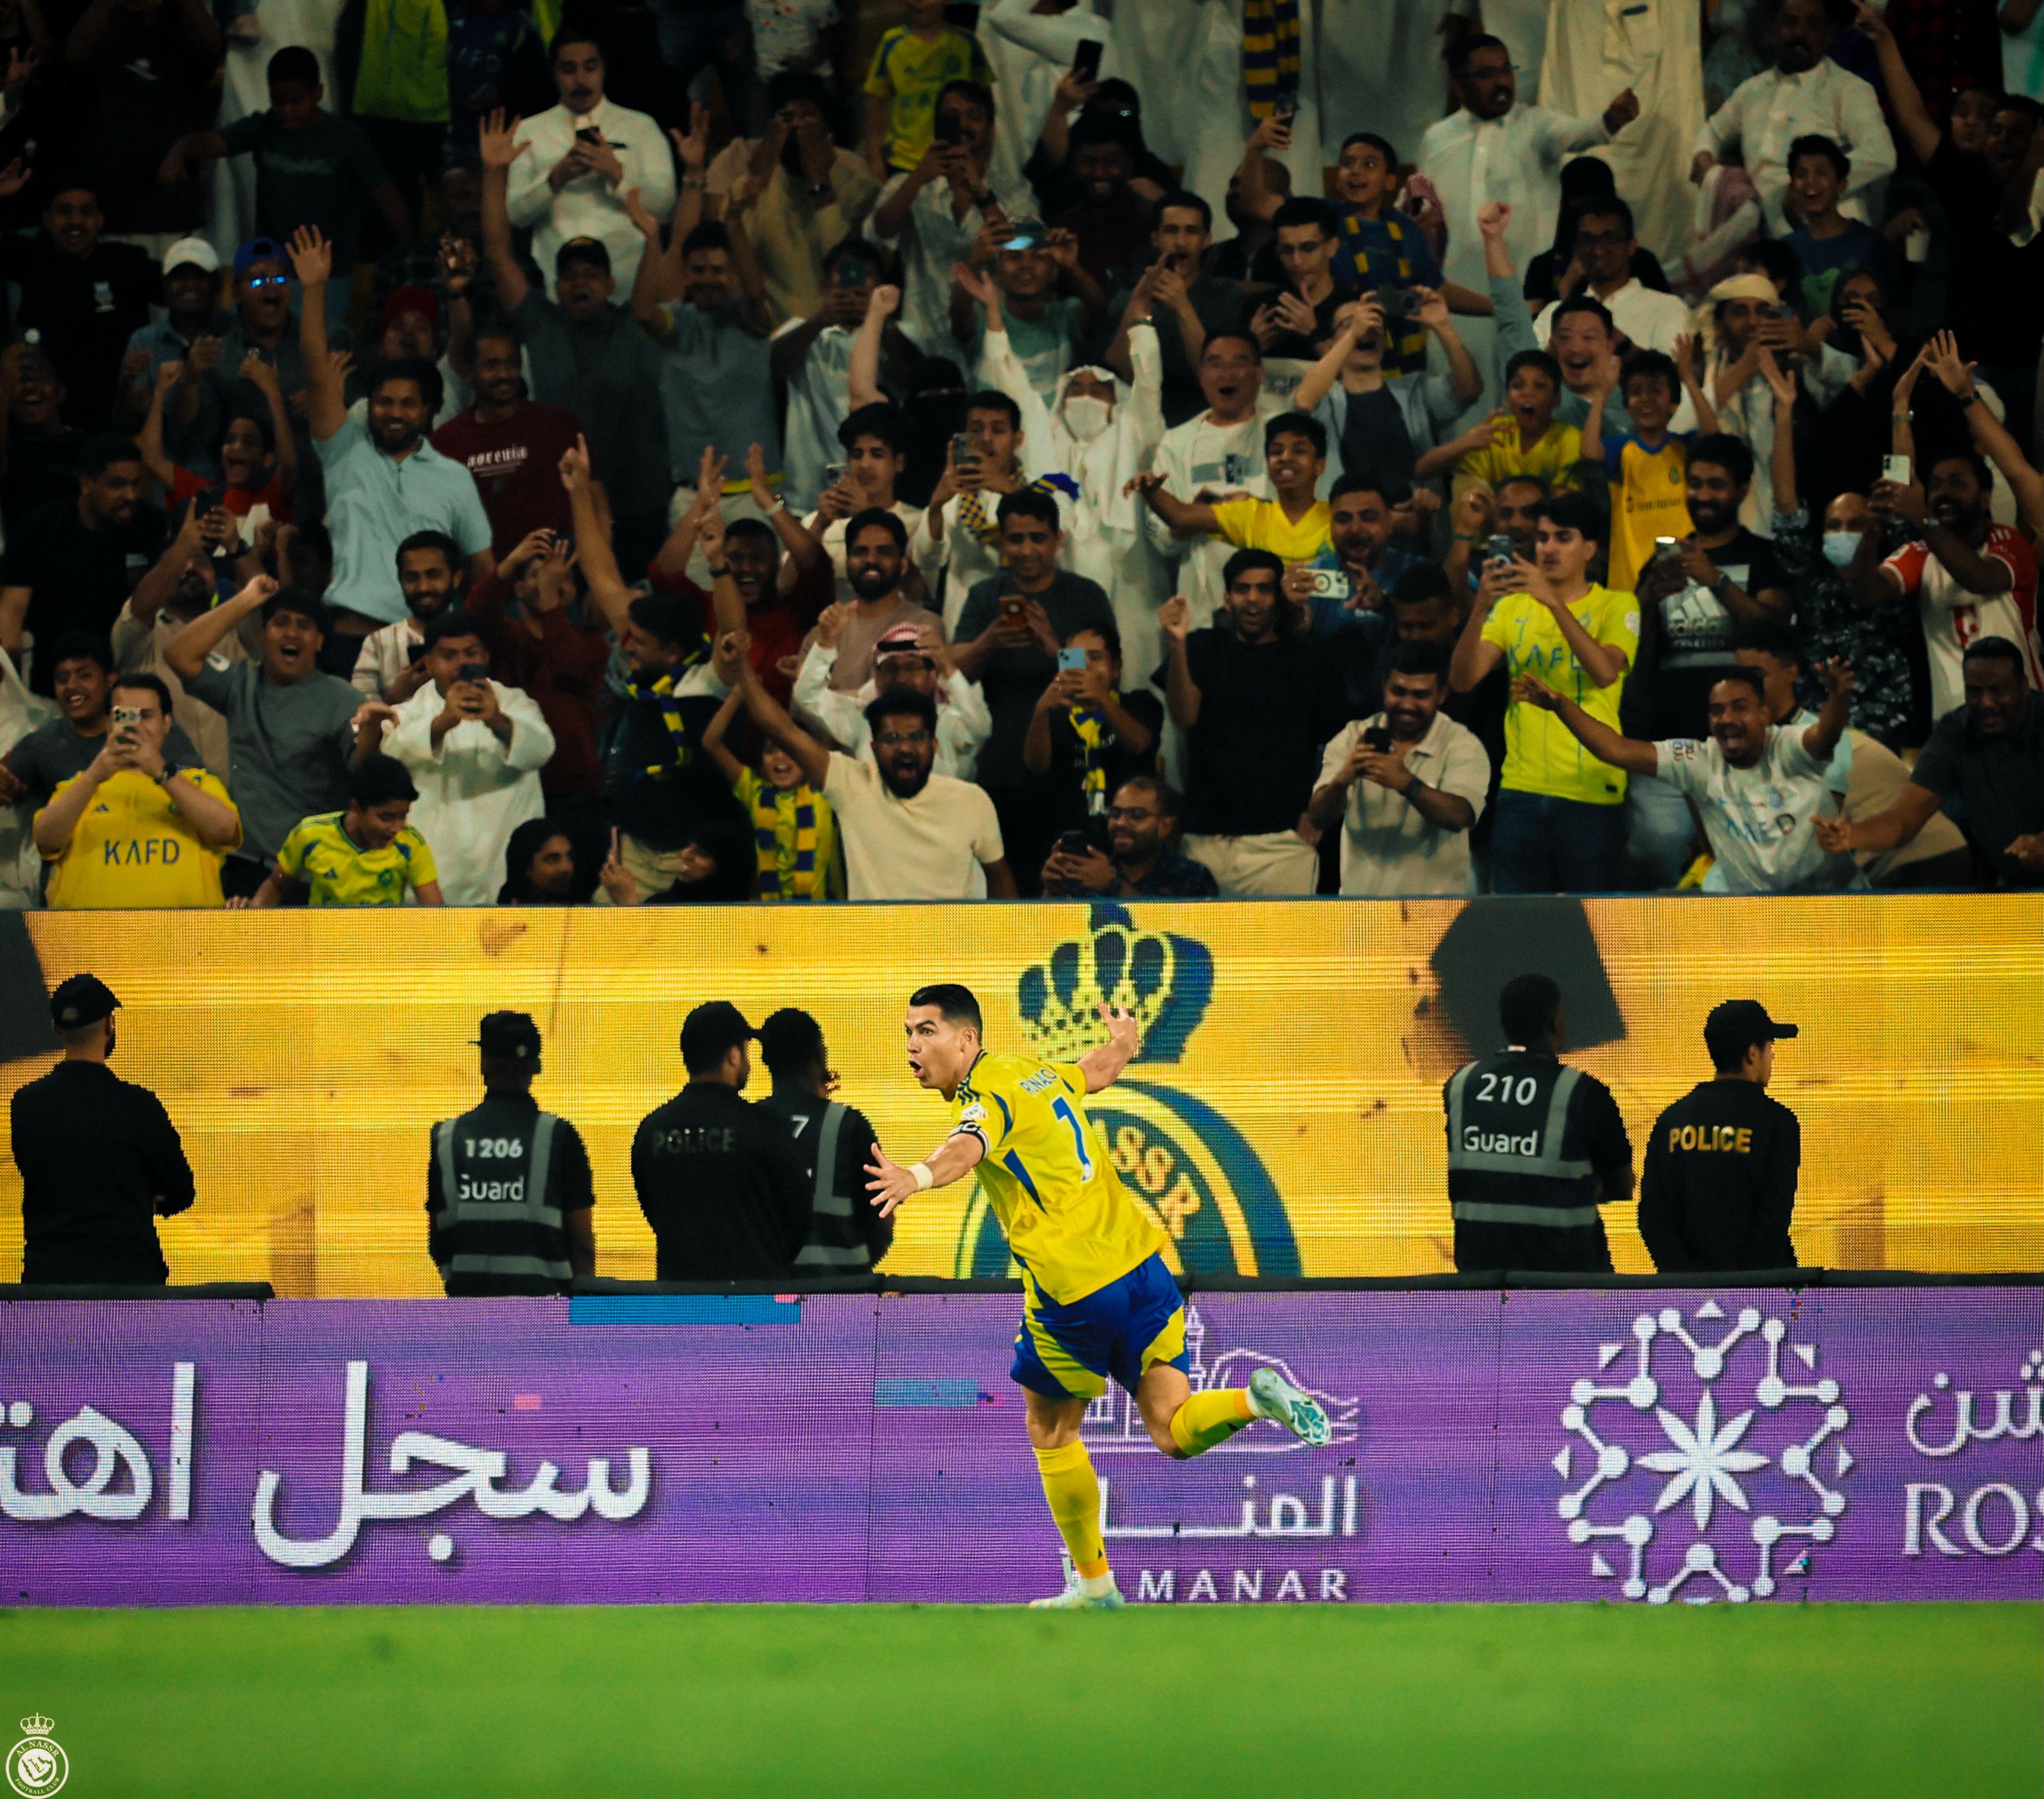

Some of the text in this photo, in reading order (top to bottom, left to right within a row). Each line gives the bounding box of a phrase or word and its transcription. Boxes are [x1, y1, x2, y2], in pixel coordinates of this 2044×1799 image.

[105, 838, 181, 866] KAFD
[1475, 1073, 1537, 1106] 210
[464, 1137, 524, 1159] 1206
[653, 1126, 736, 1155] POLICE
[1051, 1095, 1093, 1182] 1
[1464, 1125, 1539, 1156] Guard
[1669, 1124, 1753, 1154] POLICE
[252, 1360, 650, 1569] سجل
[1098, 1476, 1359, 1538] المنا
[1138, 1569, 1348, 1601] MANAR
